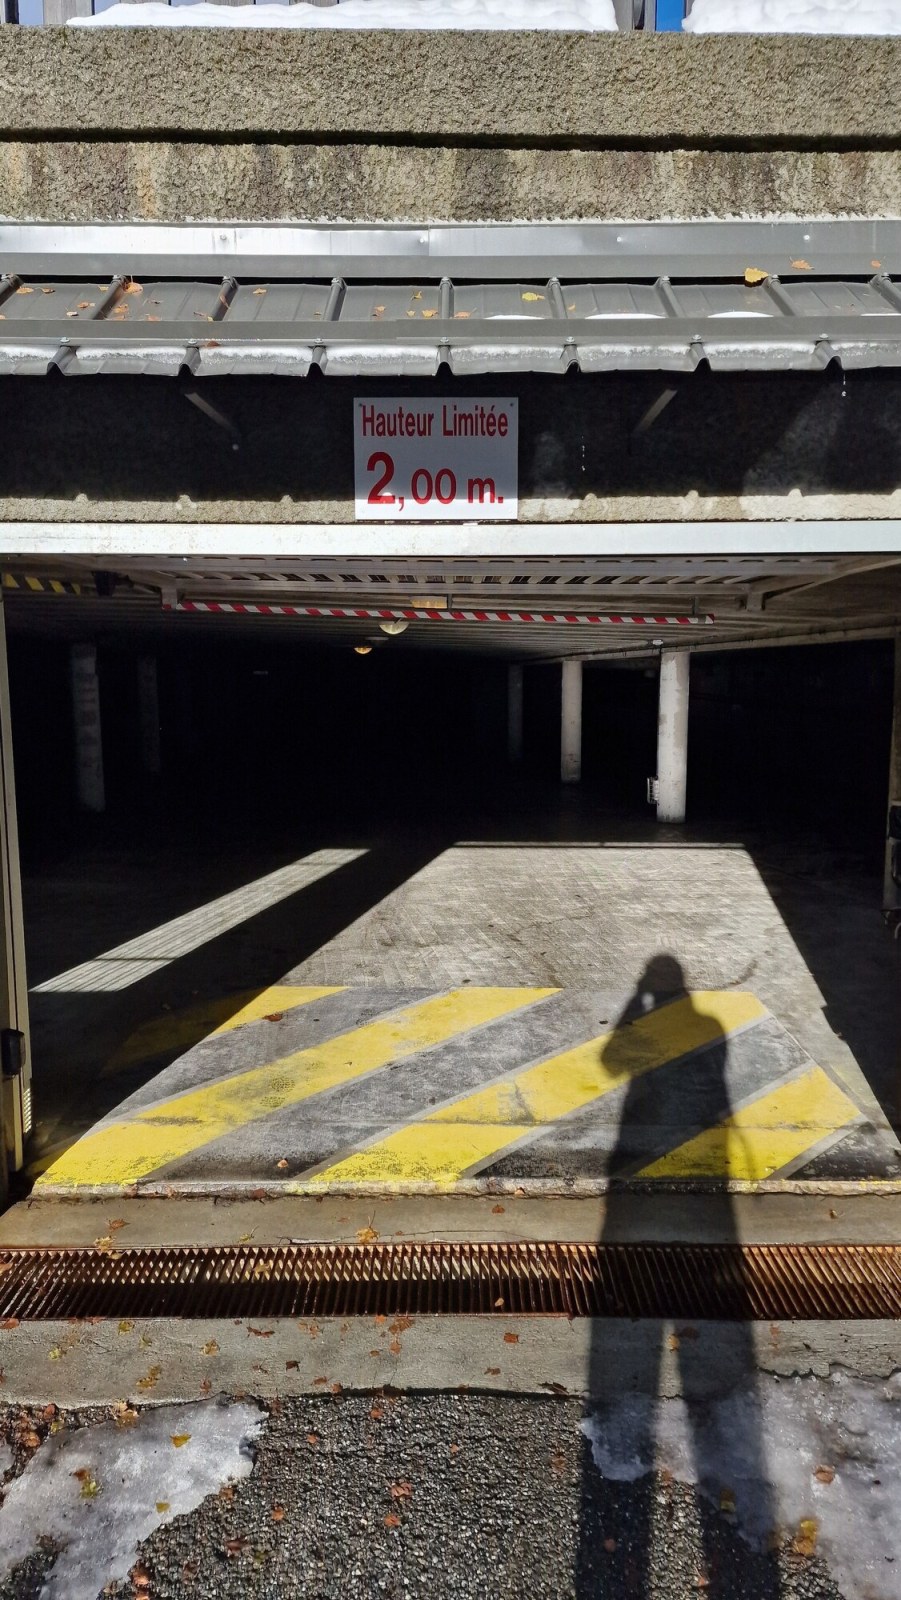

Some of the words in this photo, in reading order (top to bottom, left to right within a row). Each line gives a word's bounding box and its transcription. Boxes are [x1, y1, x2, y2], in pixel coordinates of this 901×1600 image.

[362, 404, 434, 437] Hauteur
[443, 404, 508, 437] Limitée
[367, 451, 457, 511] 2,00
[467, 477, 504, 504] m.
